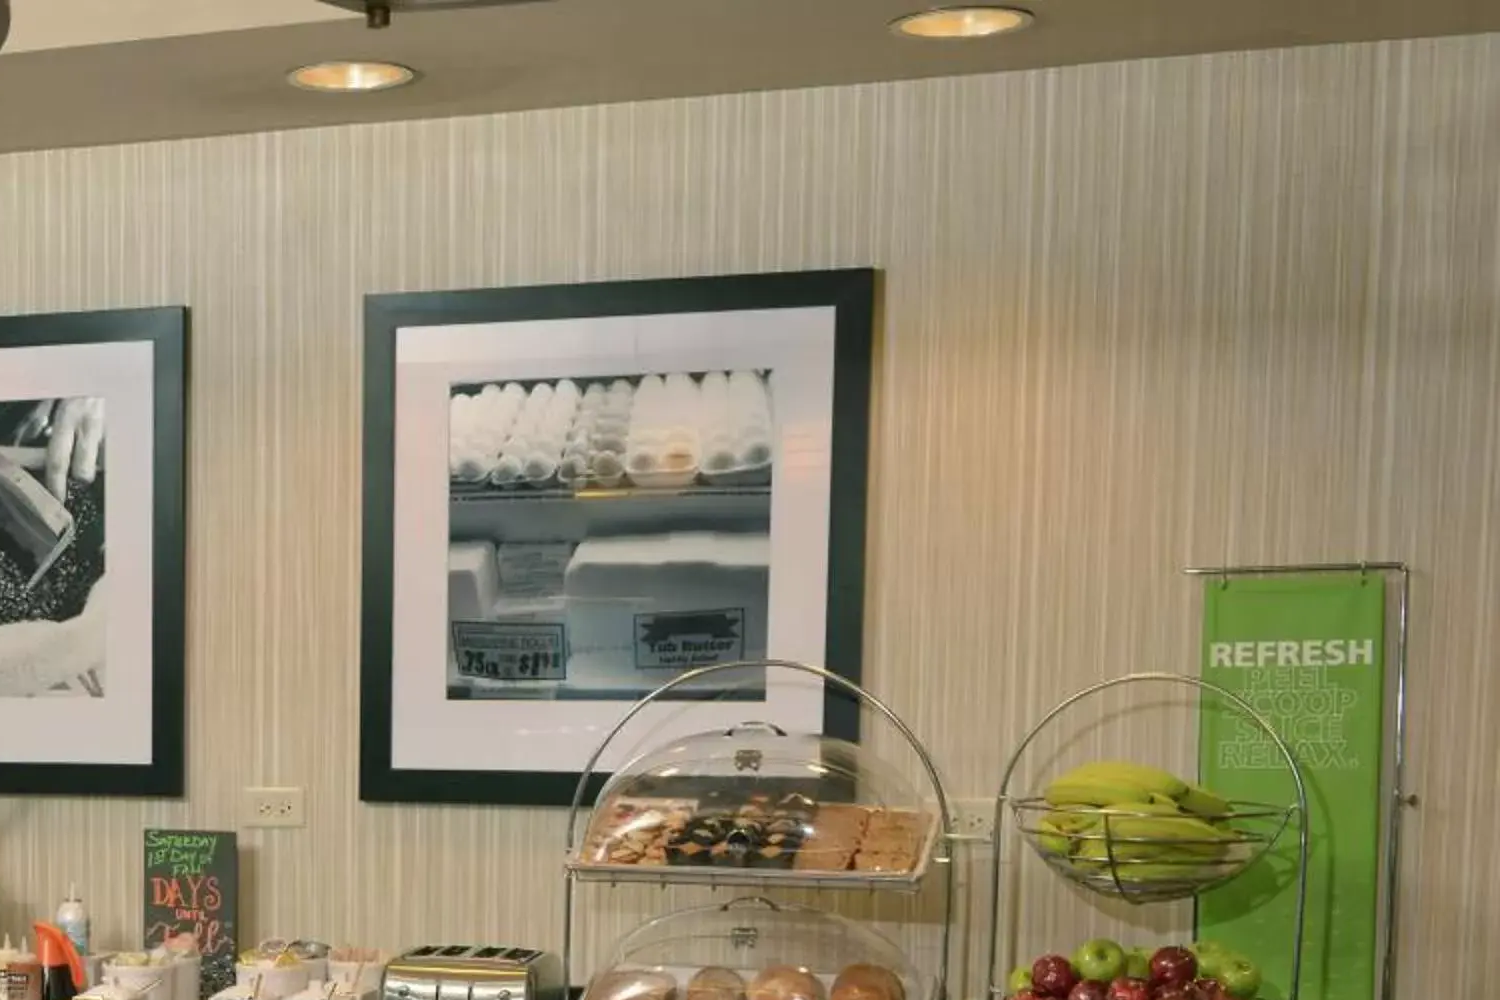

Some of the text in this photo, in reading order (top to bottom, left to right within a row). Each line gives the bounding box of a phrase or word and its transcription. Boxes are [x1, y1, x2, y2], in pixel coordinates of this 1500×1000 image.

[1210, 639, 1373, 667] REFRESH
[1244, 665, 1336, 691] PEEL
[151, 876, 222, 910] DAYS
